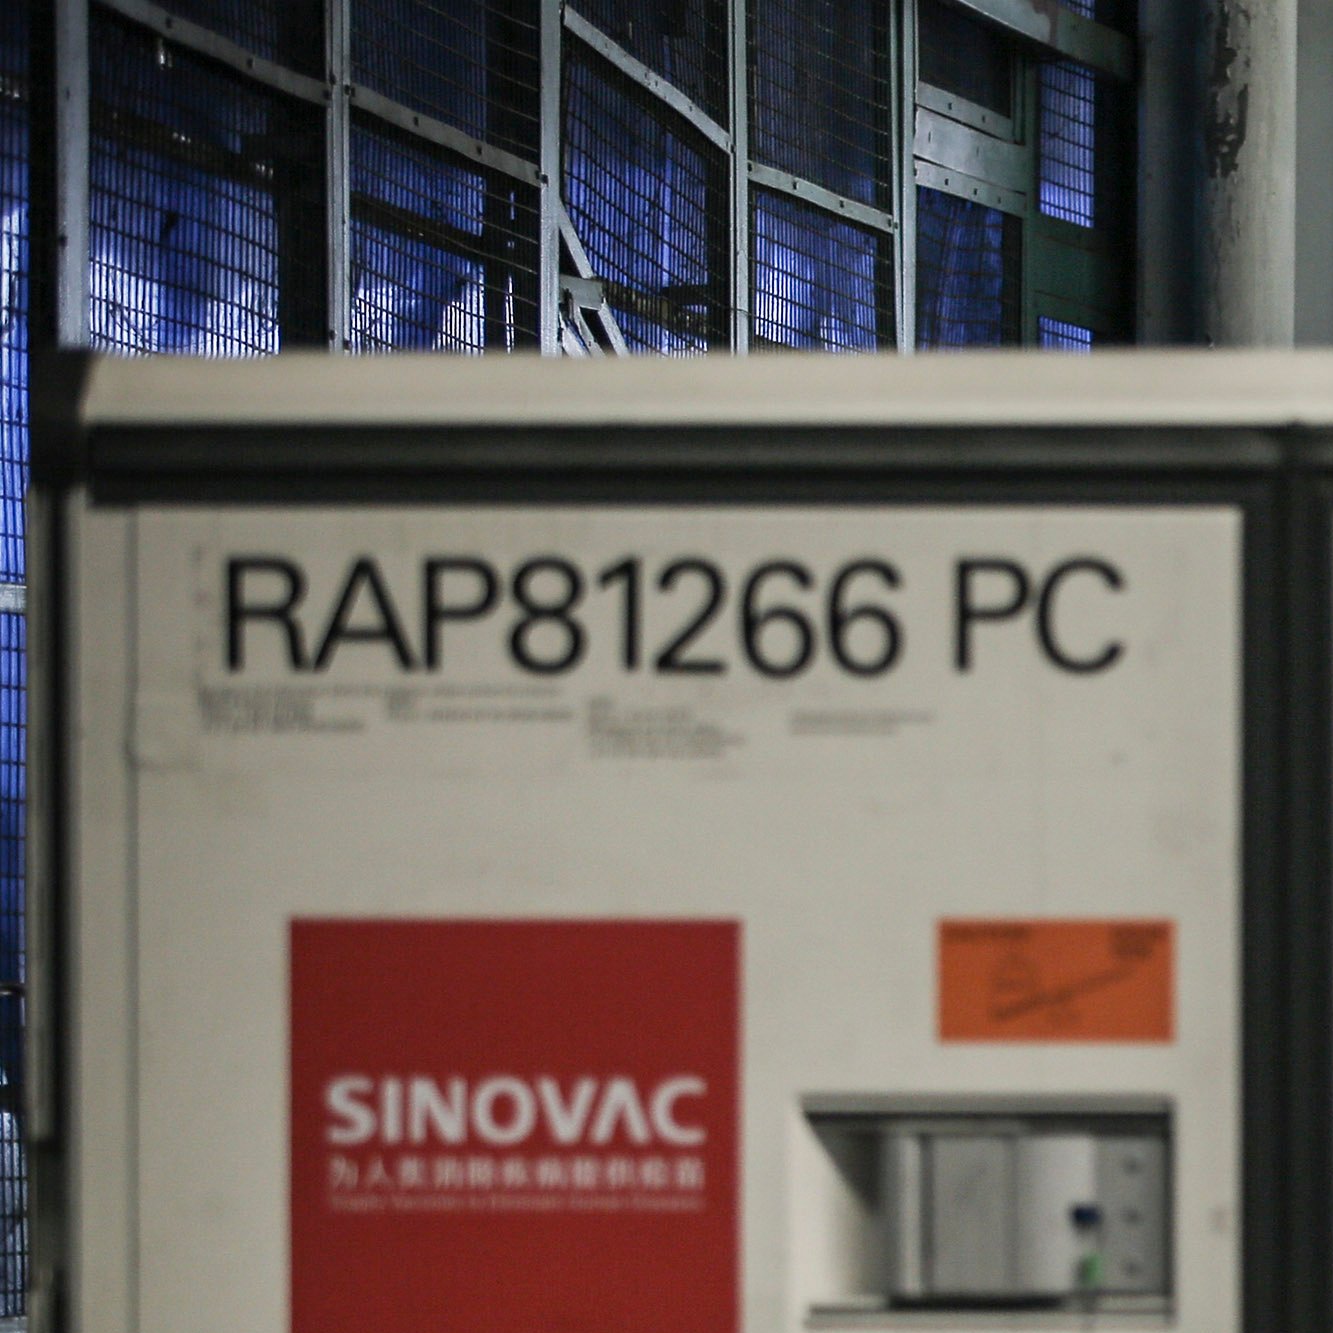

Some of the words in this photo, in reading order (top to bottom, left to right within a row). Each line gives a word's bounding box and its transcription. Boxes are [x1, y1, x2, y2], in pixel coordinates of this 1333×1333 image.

[222, 556, 904, 677] RAP81266
[953, 556, 1127, 677] PC
[325, 1074, 709, 1145] SINOVAC
